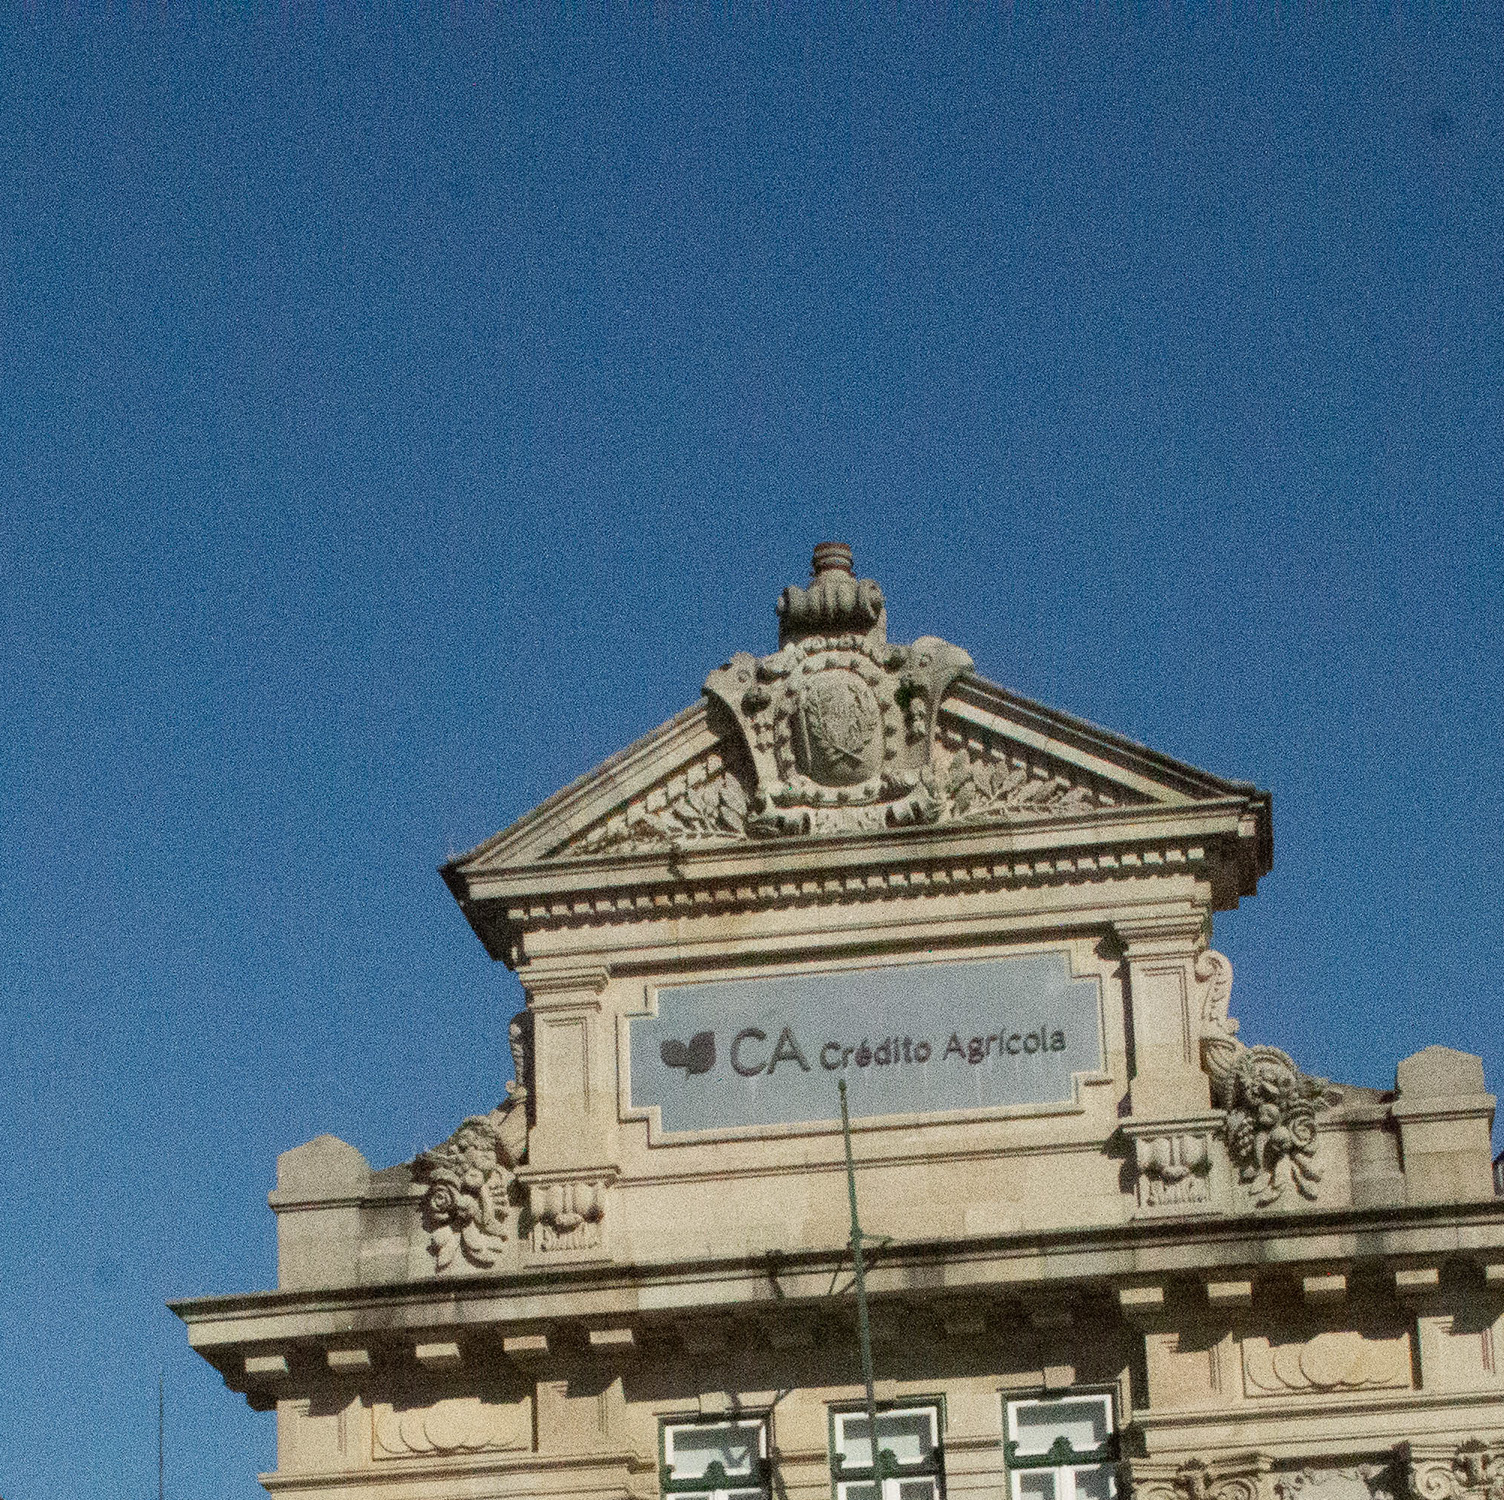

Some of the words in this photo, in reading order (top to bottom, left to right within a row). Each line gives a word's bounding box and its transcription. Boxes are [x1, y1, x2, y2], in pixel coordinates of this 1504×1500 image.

[730, 1025, 811, 1076] CA
[820, 1033, 931, 1071] Crédito
[943, 1025, 1067, 1065] Agrícola
